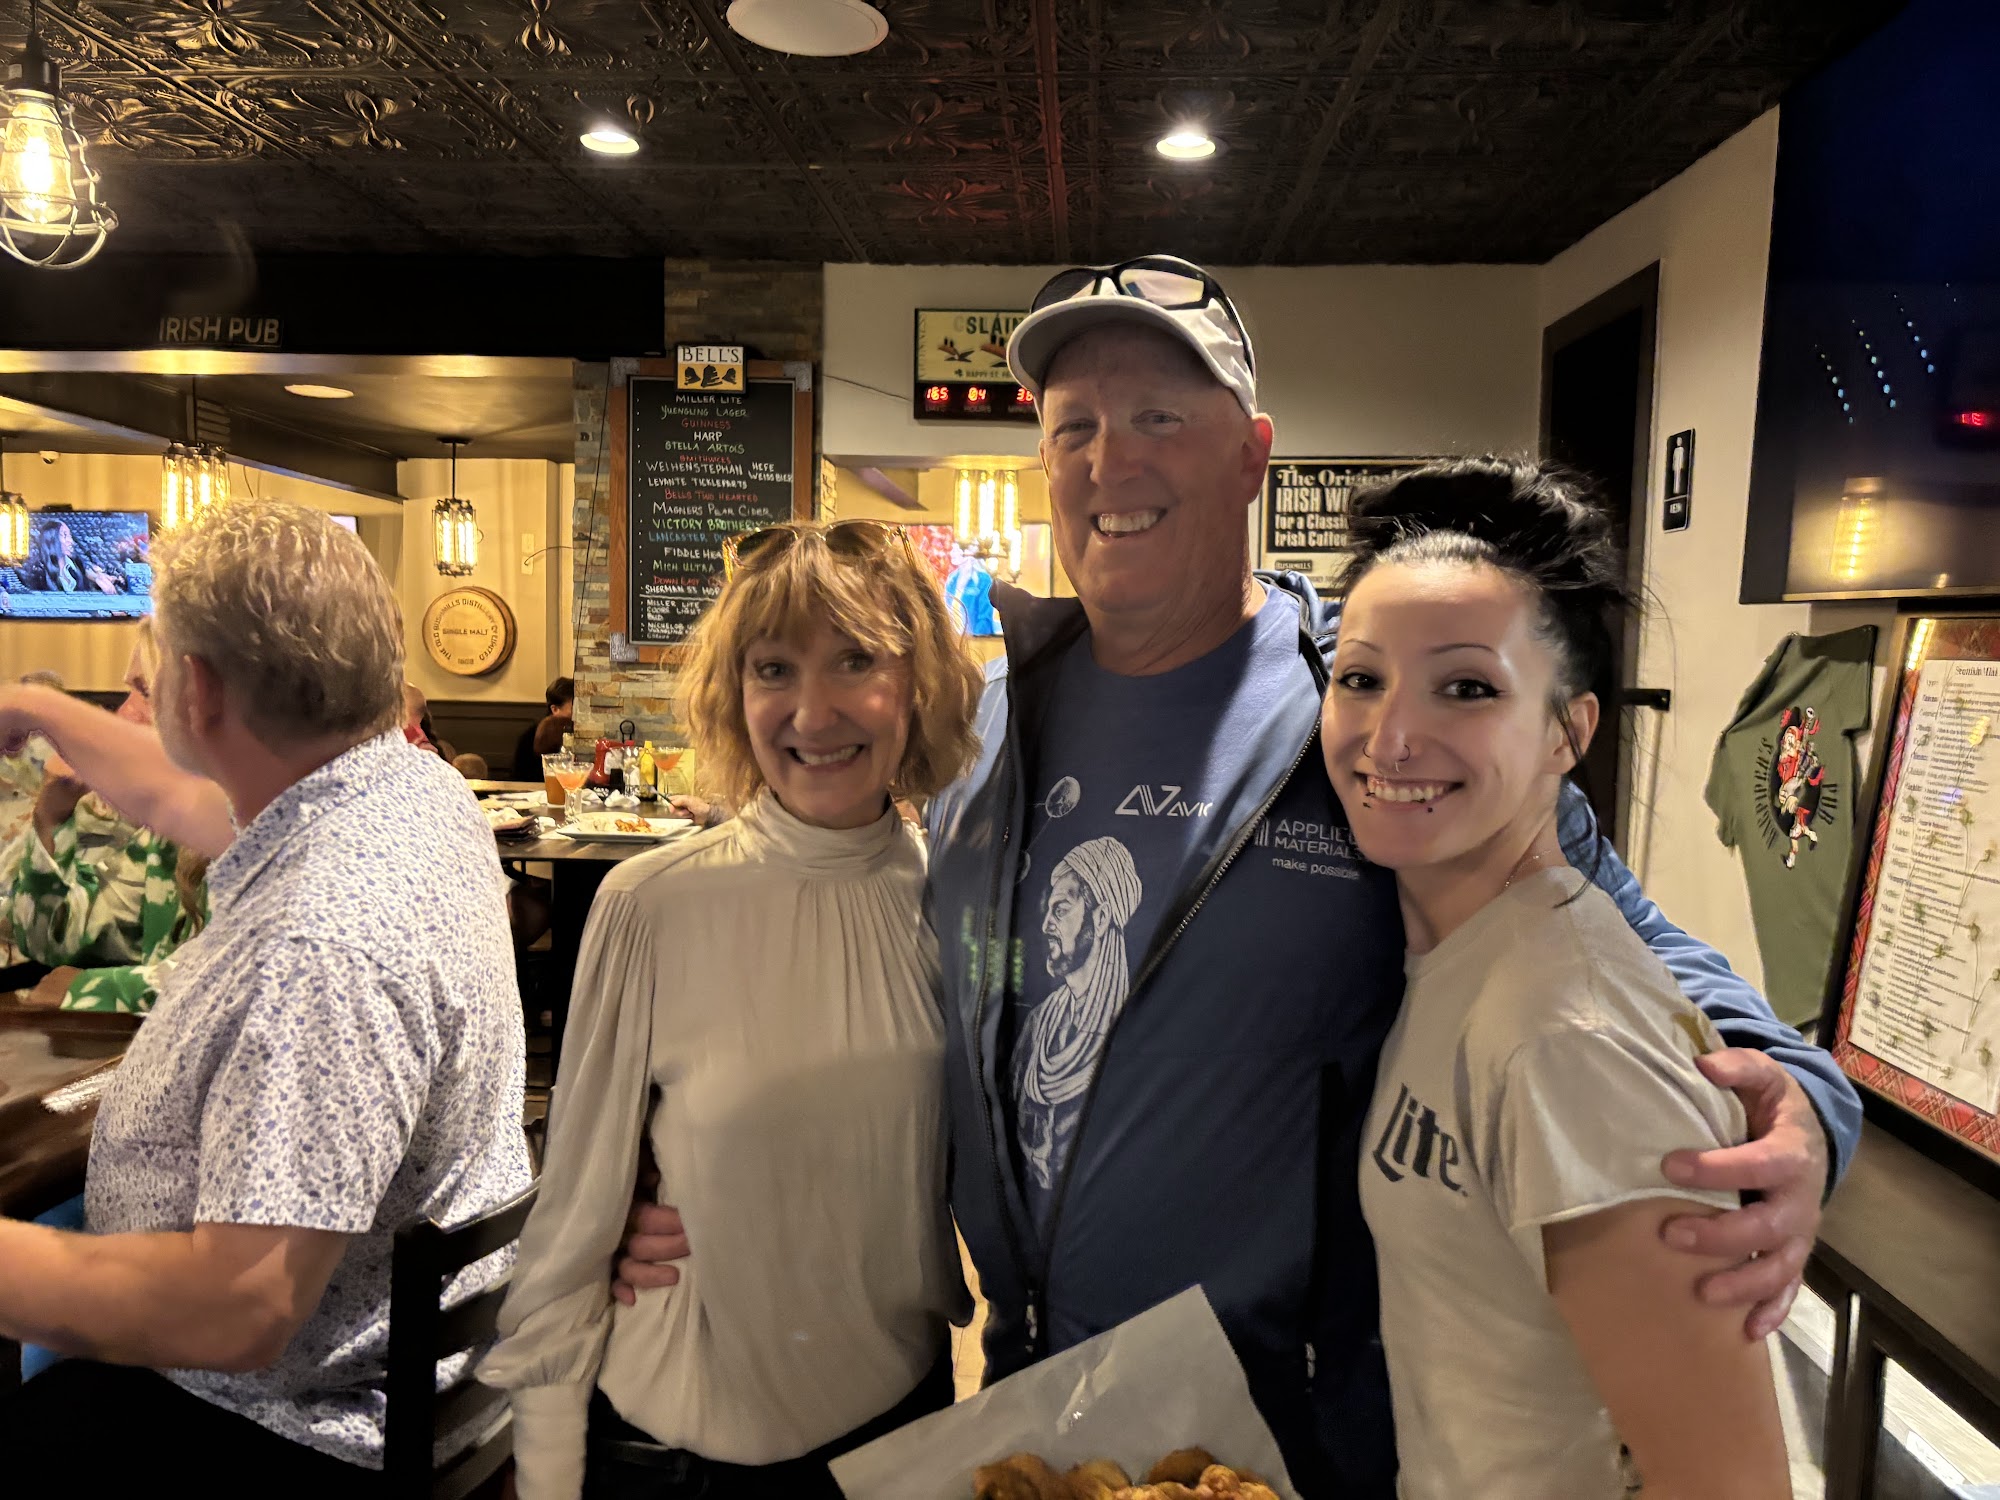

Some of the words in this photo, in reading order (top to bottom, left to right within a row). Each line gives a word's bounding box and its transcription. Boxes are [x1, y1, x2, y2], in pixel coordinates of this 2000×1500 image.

[159, 316, 222, 342] IRISH
[228, 317, 280, 344] PUB
[682, 347, 741, 363] BELL'S
[676, 395, 715, 404] MILLER
[720, 396, 742, 405] LITE
[716, 407, 748, 417] LAGER
[681, 418, 732, 429] GUINNESS
[693, 431, 723, 442] HARP
[665, 442, 700, 451] STELLA
[706, 443, 746, 454] ARTOIS
[1276, 465, 1315, 486] The
[648, 477, 687, 487] LEVANTE
[695, 490, 715, 501] TWO
[718, 493, 758, 503] HEARTED
[1276, 487, 1321, 513] IRISH
[652, 501, 703, 516] MAGNERS
[708, 502, 735, 516] PEAR
[738, 505, 773, 518] CIDER
[652, 518, 703, 530] VICTORY
[1275, 513, 1294, 530] for
[1296, 516, 1305, 530] a
[648, 531, 708, 543] LANCASTER
[1275, 531, 1306, 547] Irish
[664, 547, 700, 559] FIDDLE
[645, 584, 685, 595] SHERMAN
[646, 599, 676, 607] MILLER
[1272, 857, 1307, 872] make
[1372, 1082, 1462, 1191] Lite
